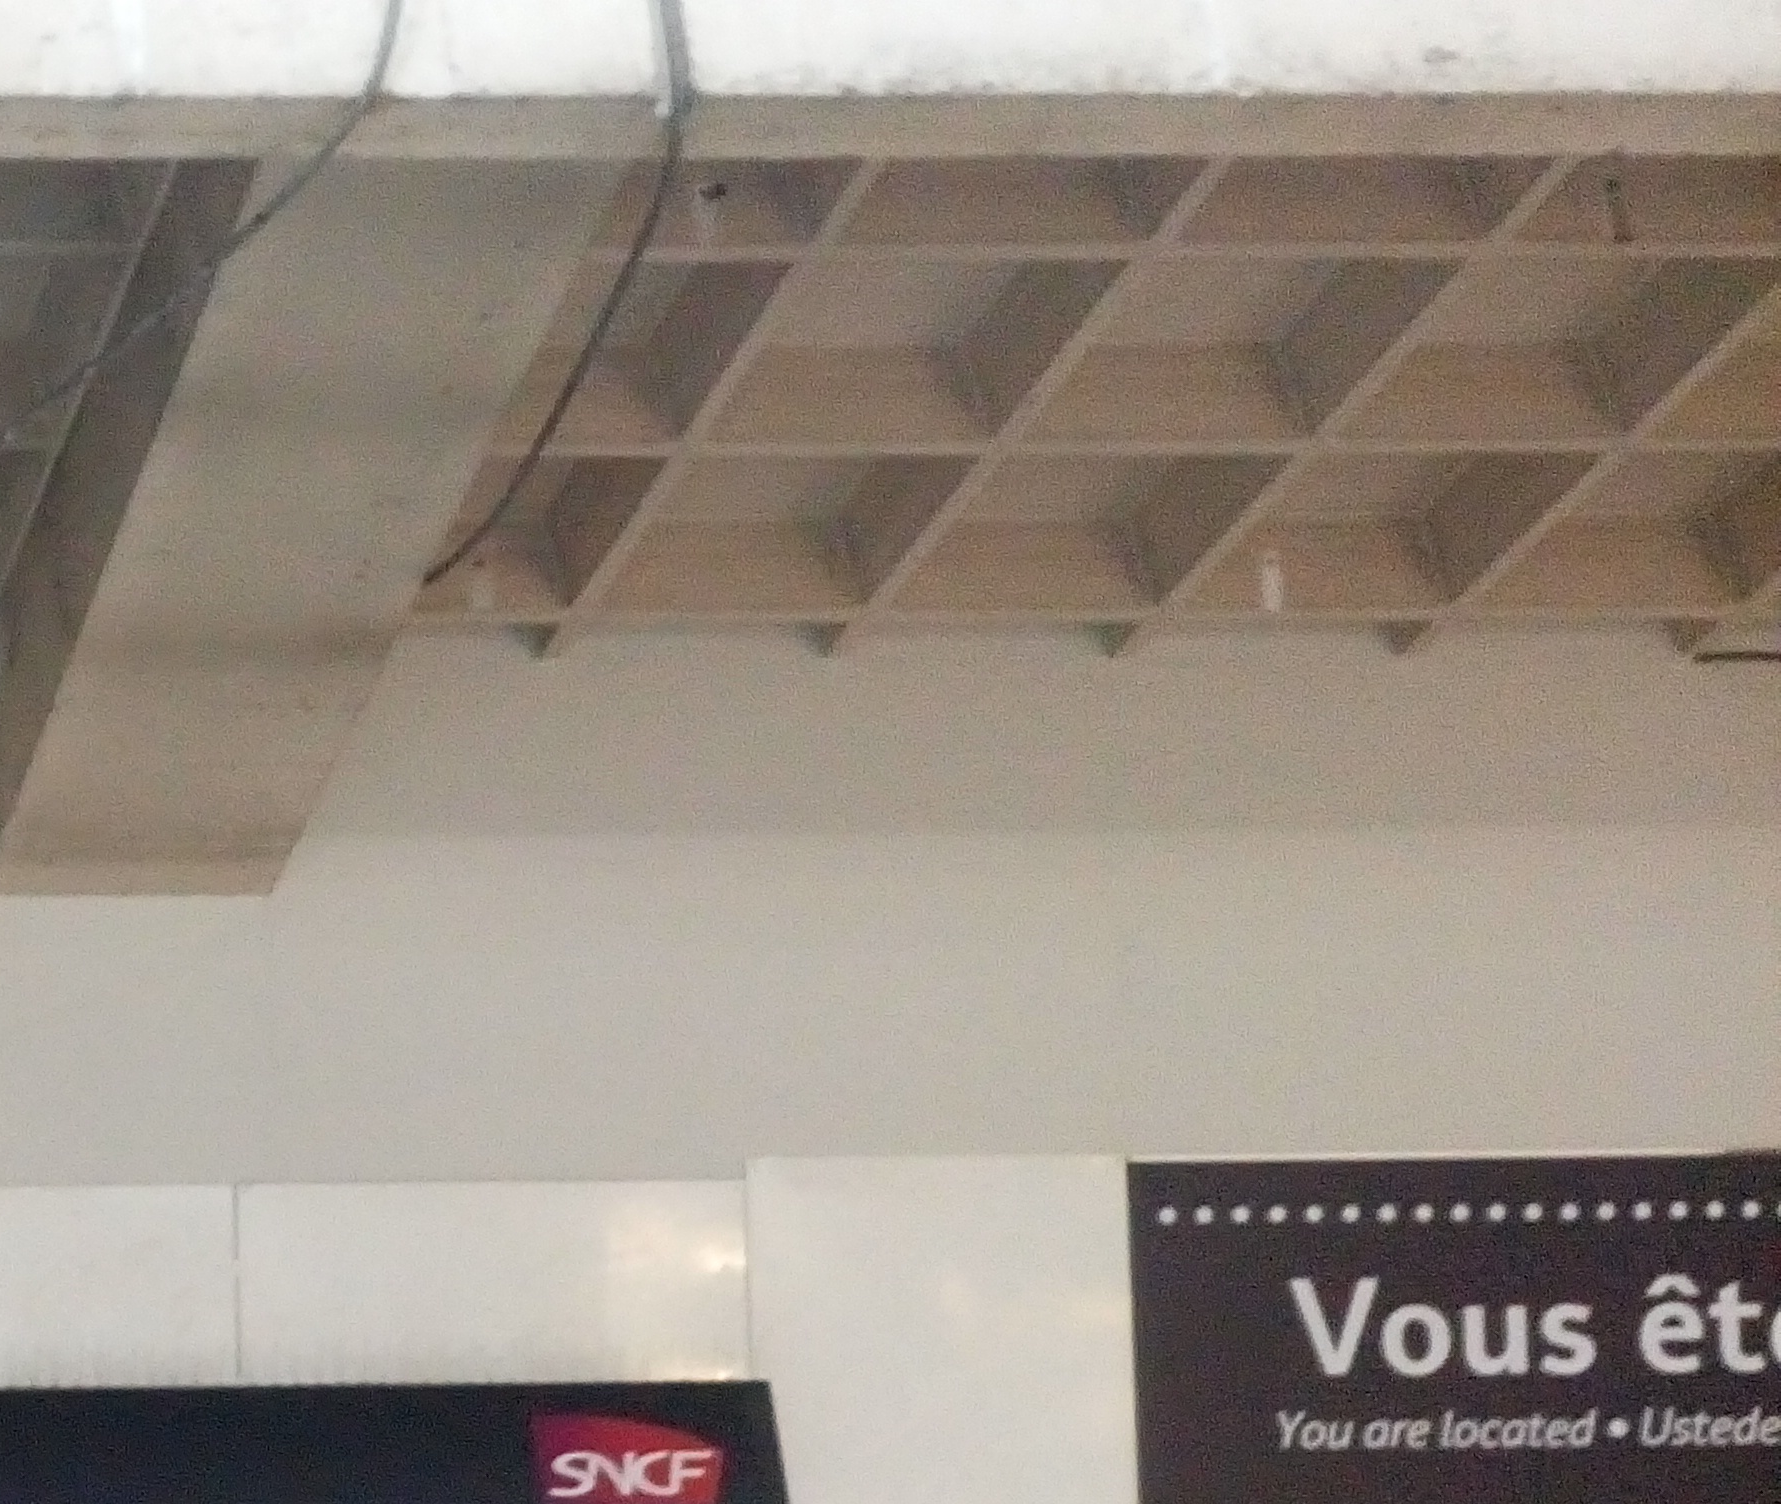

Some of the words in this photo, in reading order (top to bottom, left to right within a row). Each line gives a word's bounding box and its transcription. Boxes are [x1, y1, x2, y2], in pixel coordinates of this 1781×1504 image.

[1288, 1275, 1598, 1377] Vous
[1637, 1273, 1781, 1376] êt
[1274, 1409, 1351, 1451] You
[1362, 1419, 1429, 1449] are
[1439, 1409, 1597, 1449] located
[546, 1449, 717, 1497] SNCF
